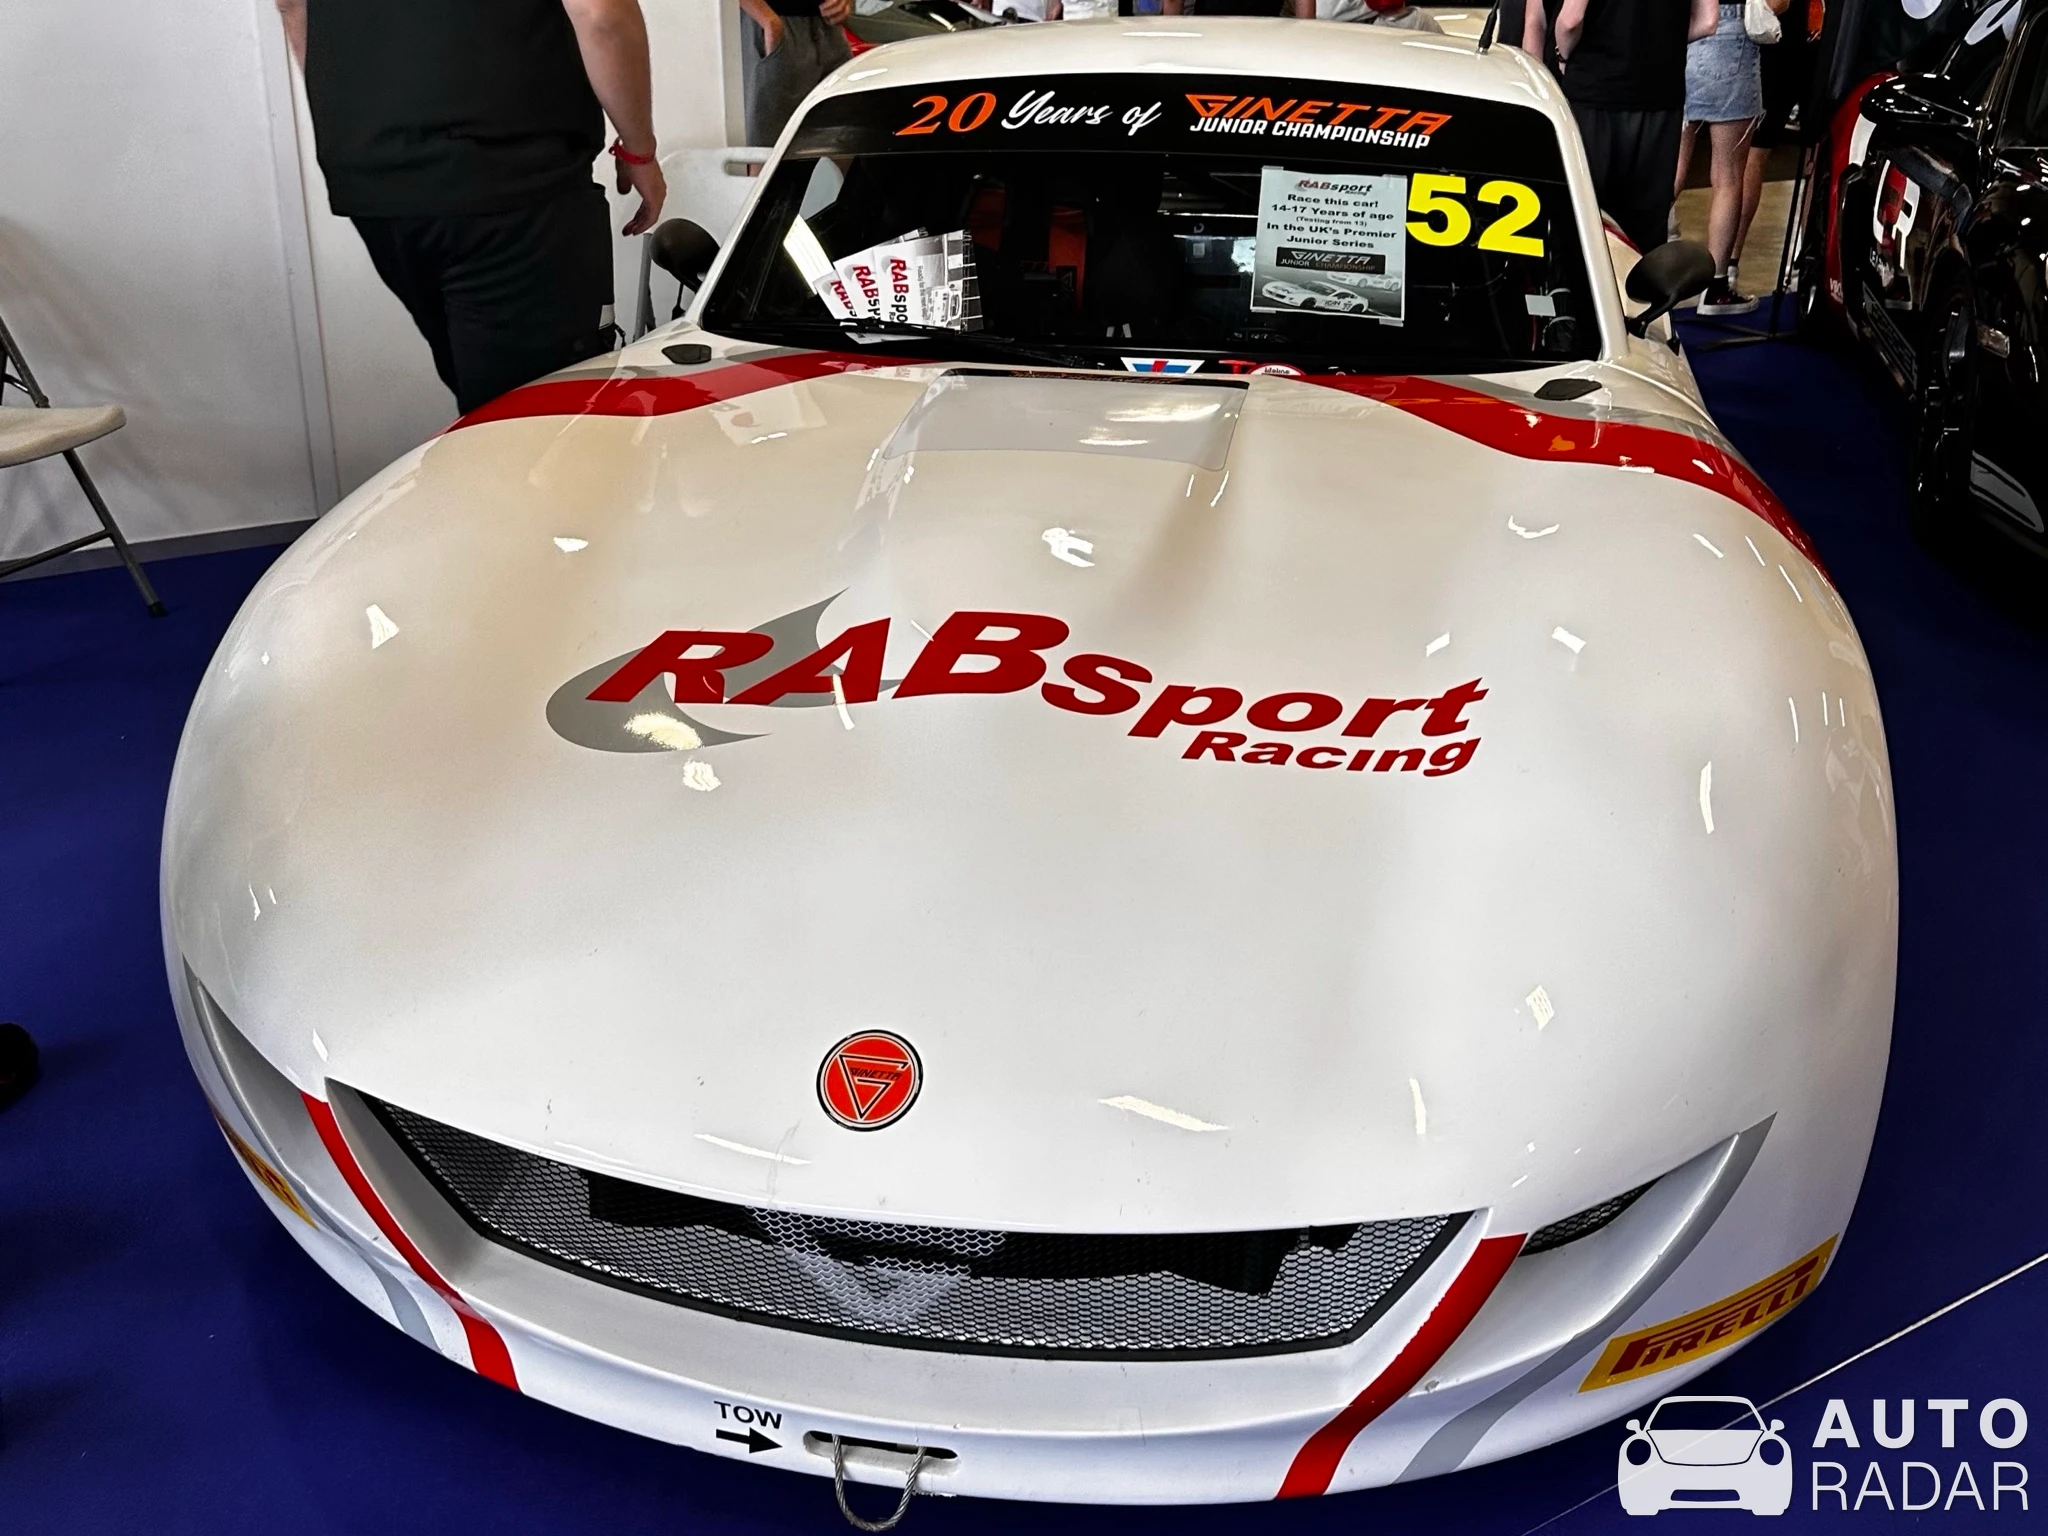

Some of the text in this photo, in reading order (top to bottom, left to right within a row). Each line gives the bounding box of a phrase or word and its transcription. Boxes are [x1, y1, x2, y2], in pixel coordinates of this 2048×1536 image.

[895, 90, 1162, 136] 20 Years of
[1185, 94, 1452, 135] GINETTA
[1190, 117, 1430, 149] JUNIOR CHAMPIONSHIP
[1298, 179, 1372, 192] RABsport
[1272, 204, 1307, 213] 14-17
[1311, 207, 1348, 217] Years
[1287, 194, 1379, 208] Race this car!
[1405, 173, 1544, 257] 52
[1267, 222, 1397, 239] In the UK's Premier
[1286, 235, 1374, 248] Junior Series
[1280, 258, 1376, 271] JUNIOR CHAMPIONSHIP
[1291, 251, 1371, 264] GINETTA
[889, 258, 909, 323] RABspo
[585, 610, 1488, 738] RABsport
[1181, 730, 1482, 777] Racing
[1609, 1256, 1820, 1376] PIRELLI
[713, 1401, 782, 1429] TOW
